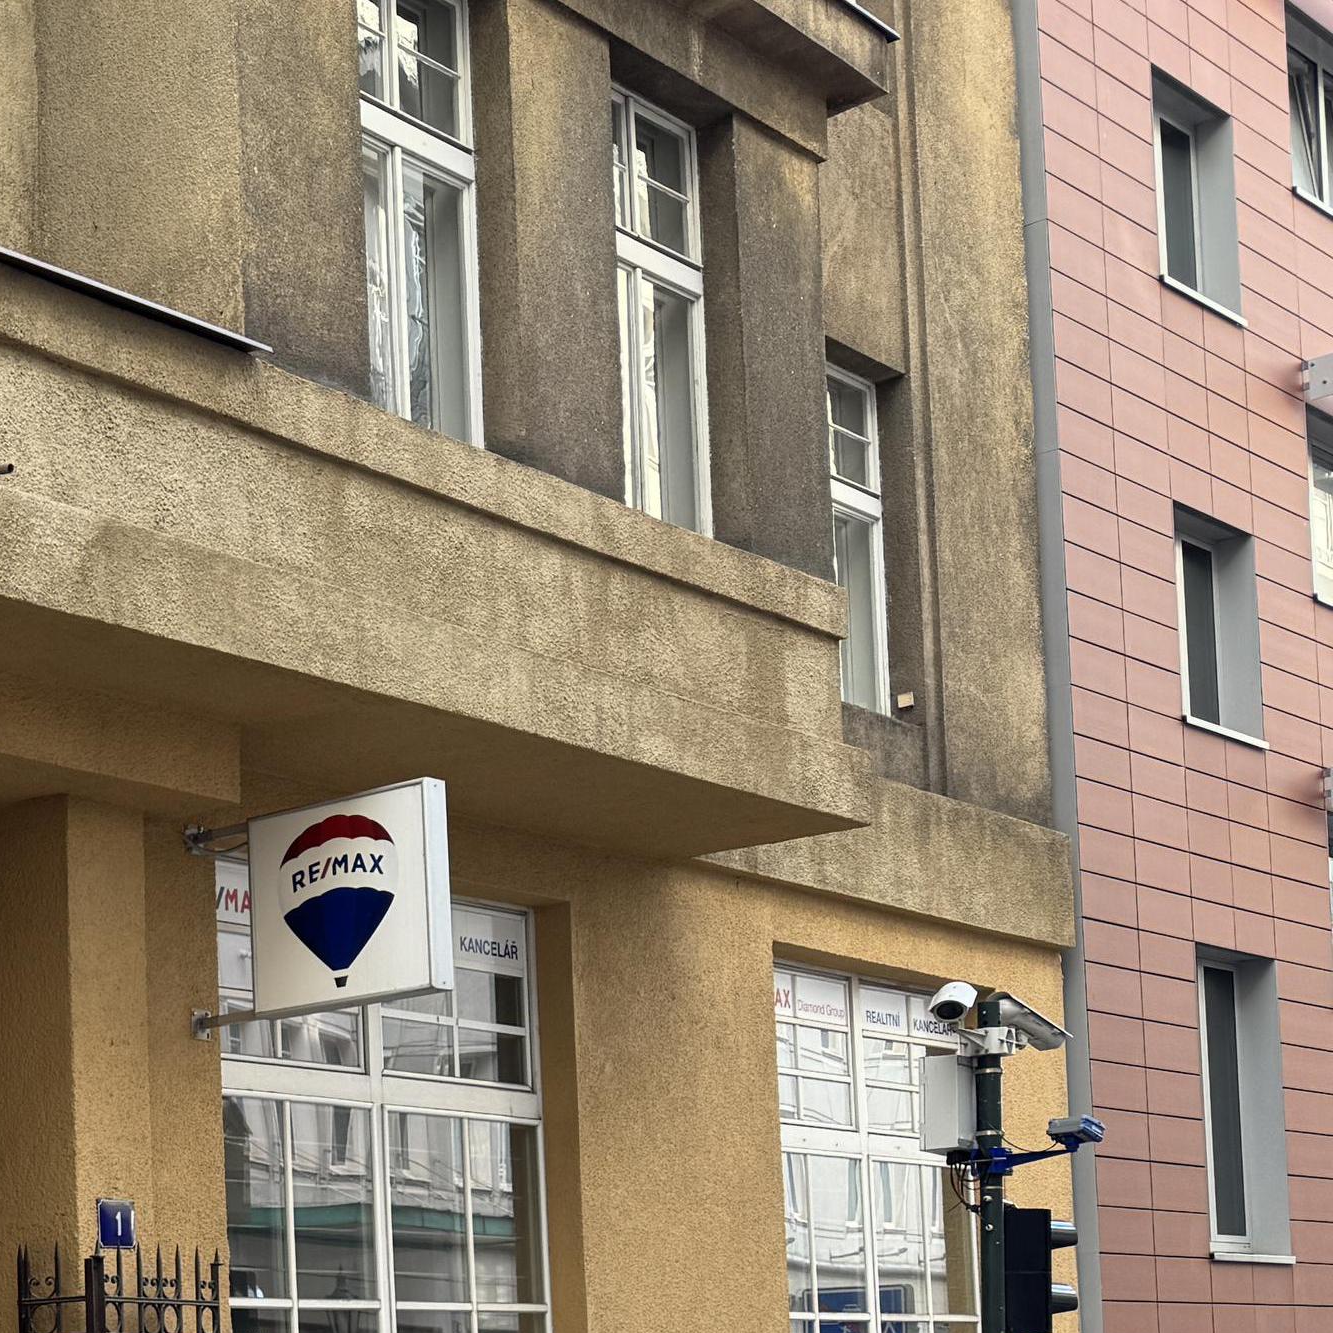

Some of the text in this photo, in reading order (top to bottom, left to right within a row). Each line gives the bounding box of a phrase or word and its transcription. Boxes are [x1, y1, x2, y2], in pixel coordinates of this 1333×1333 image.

[291, 853, 384, 893] RE/MAX
[460, 936, 518, 961] KANCELÁŘ
[797, 999, 845, 1019] Diamond Group
[865, 1009, 900, 1028] REALITNÍ
